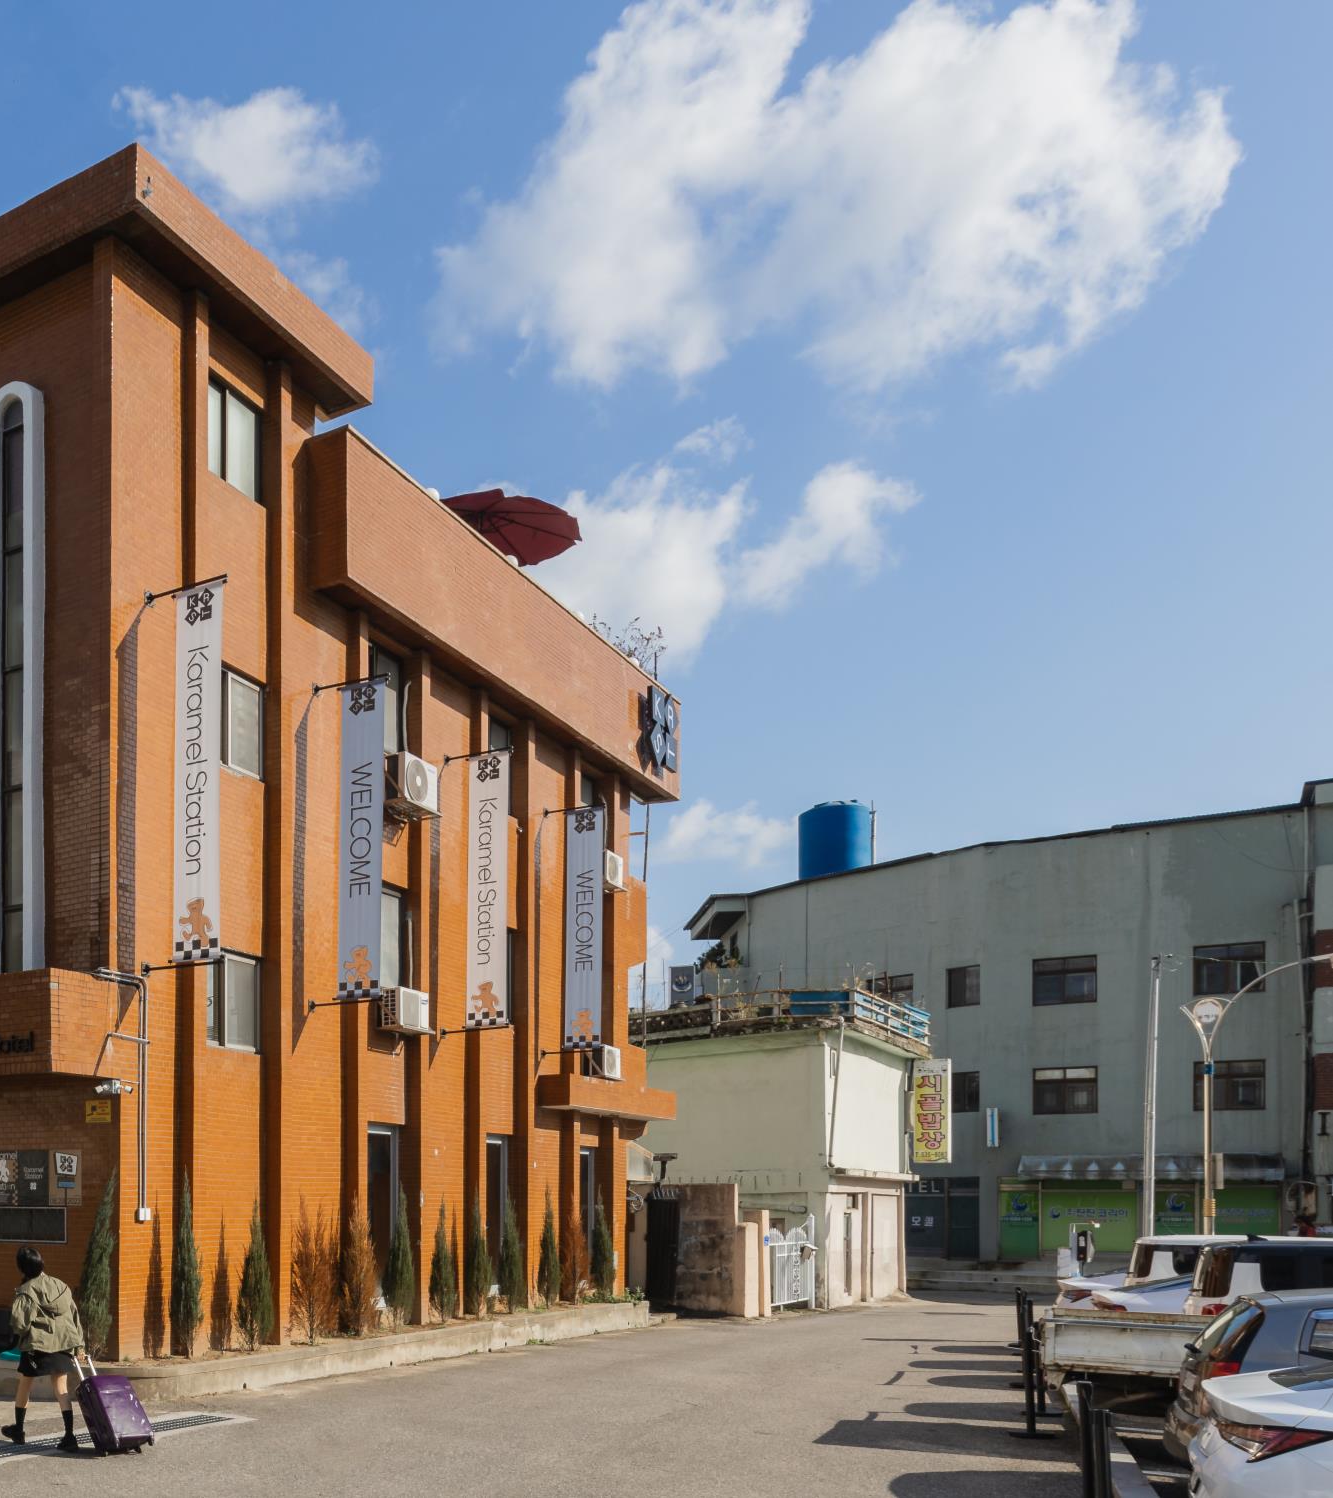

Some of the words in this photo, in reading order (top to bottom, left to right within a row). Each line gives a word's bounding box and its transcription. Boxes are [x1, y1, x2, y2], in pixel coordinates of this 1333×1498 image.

[185, 645, 209, 766] Karamel
[185, 770, 208, 876] Station
[348, 761, 373, 899] WELCOME
[477, 797, 498, 887] Karamel
[477, 888, 497, 966] Station
[575, 869, 594, 973] WELCOME
[916, 1074, 946, 1150] 시골밥상
